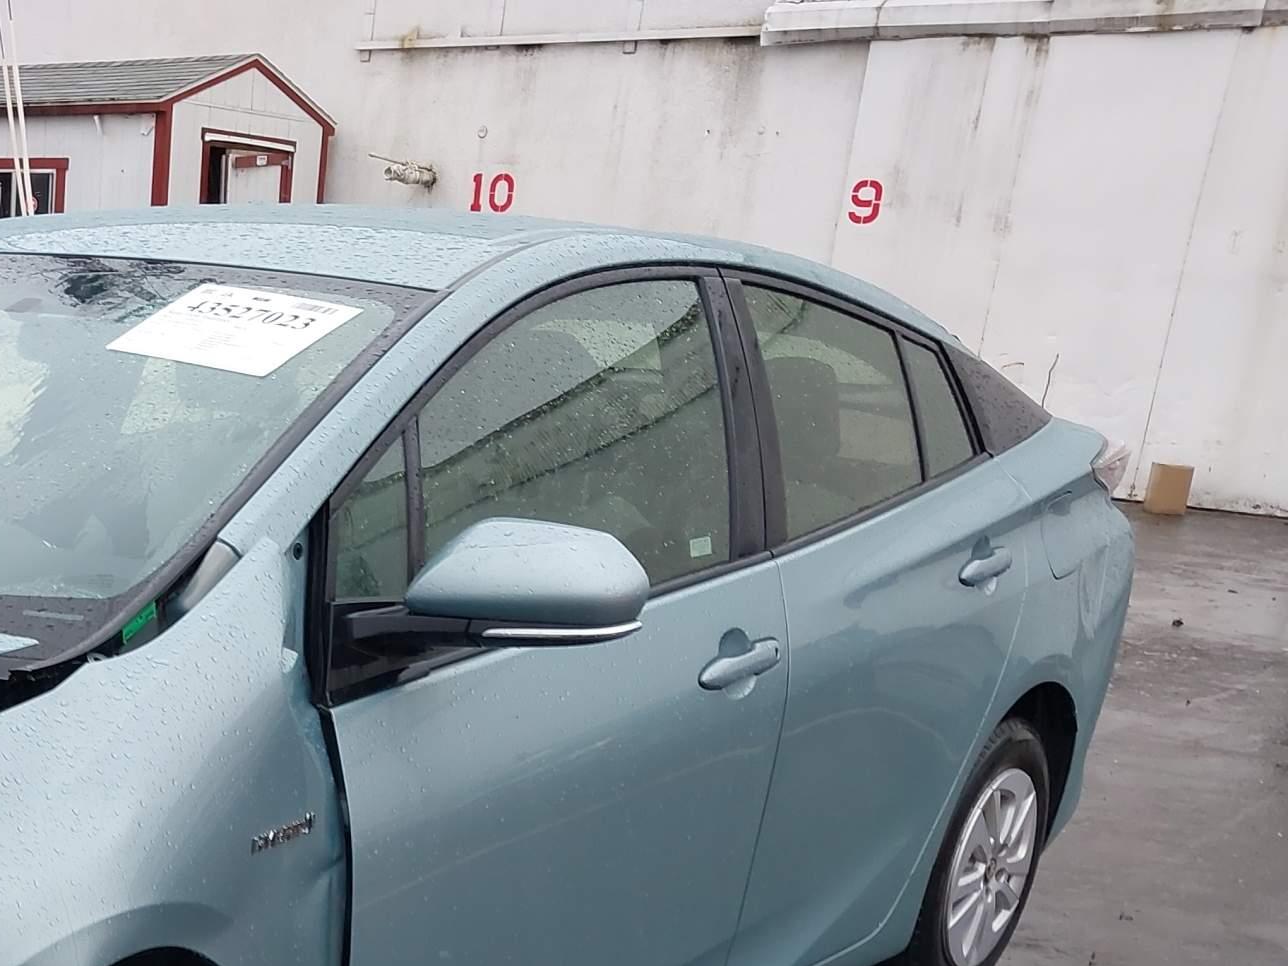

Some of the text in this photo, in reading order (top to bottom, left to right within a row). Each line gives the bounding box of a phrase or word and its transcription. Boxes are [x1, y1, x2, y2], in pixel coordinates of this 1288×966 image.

[469, 172, 516, 213] 10
[847, 179, 885, 225] 9
[187, 300, 316, 330] 43527023
